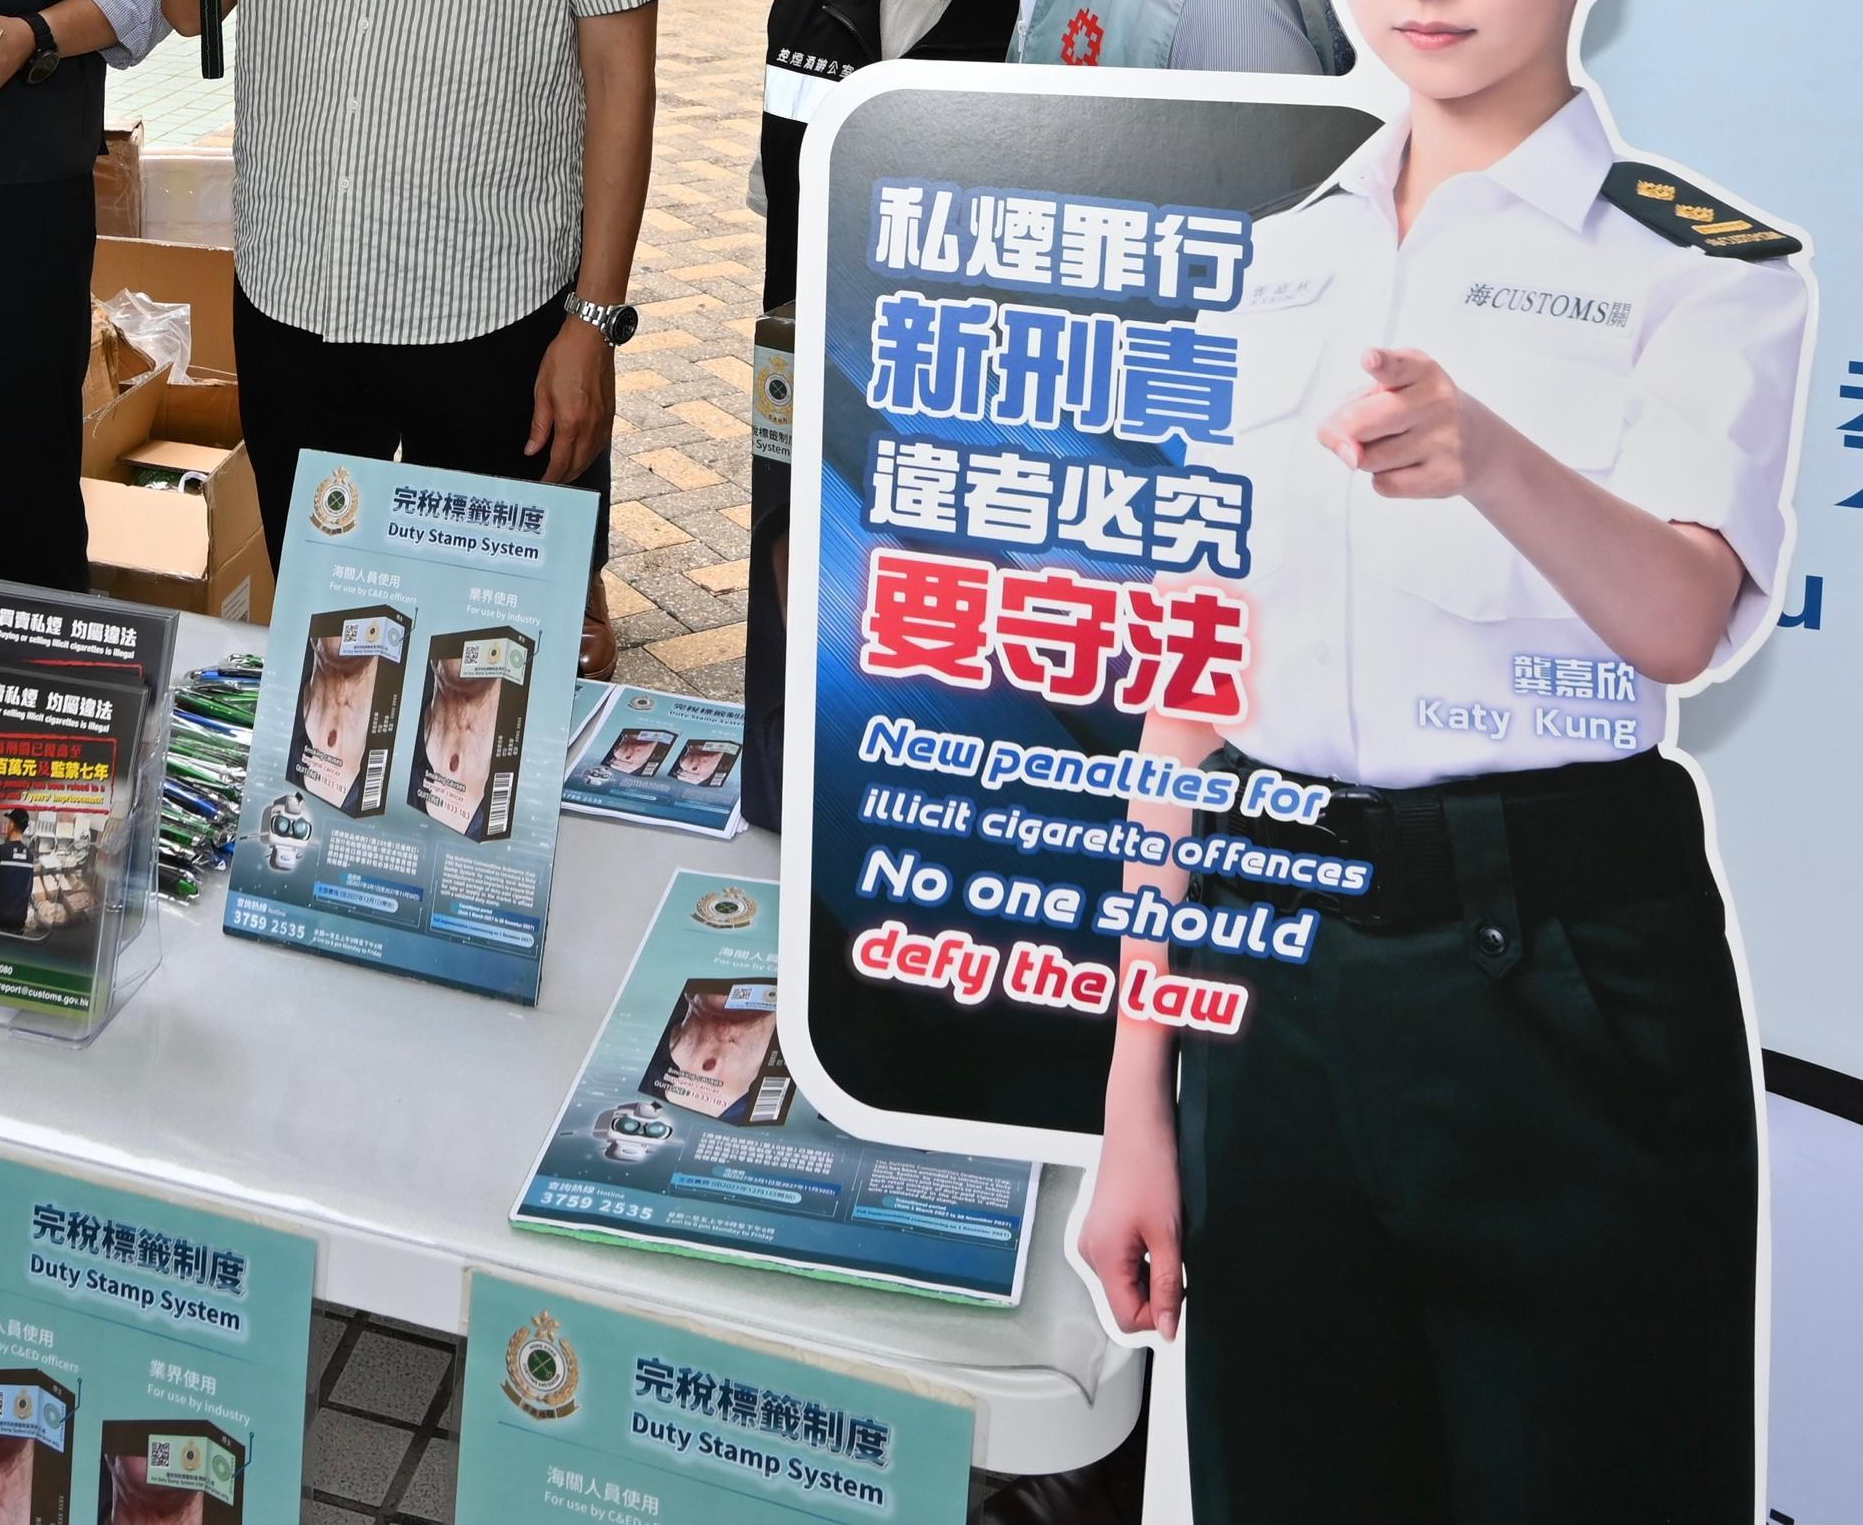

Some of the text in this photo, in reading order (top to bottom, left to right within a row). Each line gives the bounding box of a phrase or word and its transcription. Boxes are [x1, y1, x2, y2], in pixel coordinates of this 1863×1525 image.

[875, 185, 1244, 301] 私煙罪行
[868, 291, 1239, 446] 新刑責
[392, 484, 546, 536] 完稅標籤制度
[869, 439, 1244, 571] 違者必究
[387, 522, 539, 561] Duty Stamp System
[330, 582, 341, 591] For
[343, 586, 356, 595] use
[357, 587, 367, 597] by
[70, 619, 136, 647] 均屬違法
[466, 605, 541, 626] For use by industry
[861, 547, 1249, 723] 要守法
[29, 636, 51, 647] selling
[70, 642, 104, 655] cigarettes
[105, 647, 112, 655] is
[113, 648, 135, 659] illegal
[1513, 654, 1637, 703] 龔嘉欣
[3, 709, 25, 721] selling
[45, 715, 79, 729] cigarettes
[80, 720, 87, 729] is
[88, 721, 110, 733] illegal
[46, 691, 113, 721] 均屬違法
[1417, 699, 1637, 750] Katy Kung
[862, 719, 1328, 822] New penalties for
[864, 789, 1368, 889] illicit cigarette offences
[233, 910, 305, 939] 3759 2535
[860, 850, 1318, 957] No one should
[714, 957, 730, 965] For
[752, 963, 764, 971] by
[857, 926, 1243, 1028] defy the law
[540, 1192, 654, 1220] 3759 2535
[32, 1202, 248, 1297] 完稅標籤制度
[751, 1230, 774, 1241] Friday
[29, 1253, 242, 1333] Duty Stamp System
[10, 1343, 39, 1362] C&ED
[41, 1350, 80, 1374] officers
[149, 1358, 217, 1396] 業界使用
[147, 1383, 251, 1426] For use by industry
[634, 1356, 893, 1470] 完稅標籤制度
[632, 1411, 885, 1506] Duty Stamp System
[544, 1491, 564, 1506] For
[567, 1501, 588, 1513] use
[590, 1502, 605, 1521] by
[546, 1465, 659, 1516] 海關人員使用
